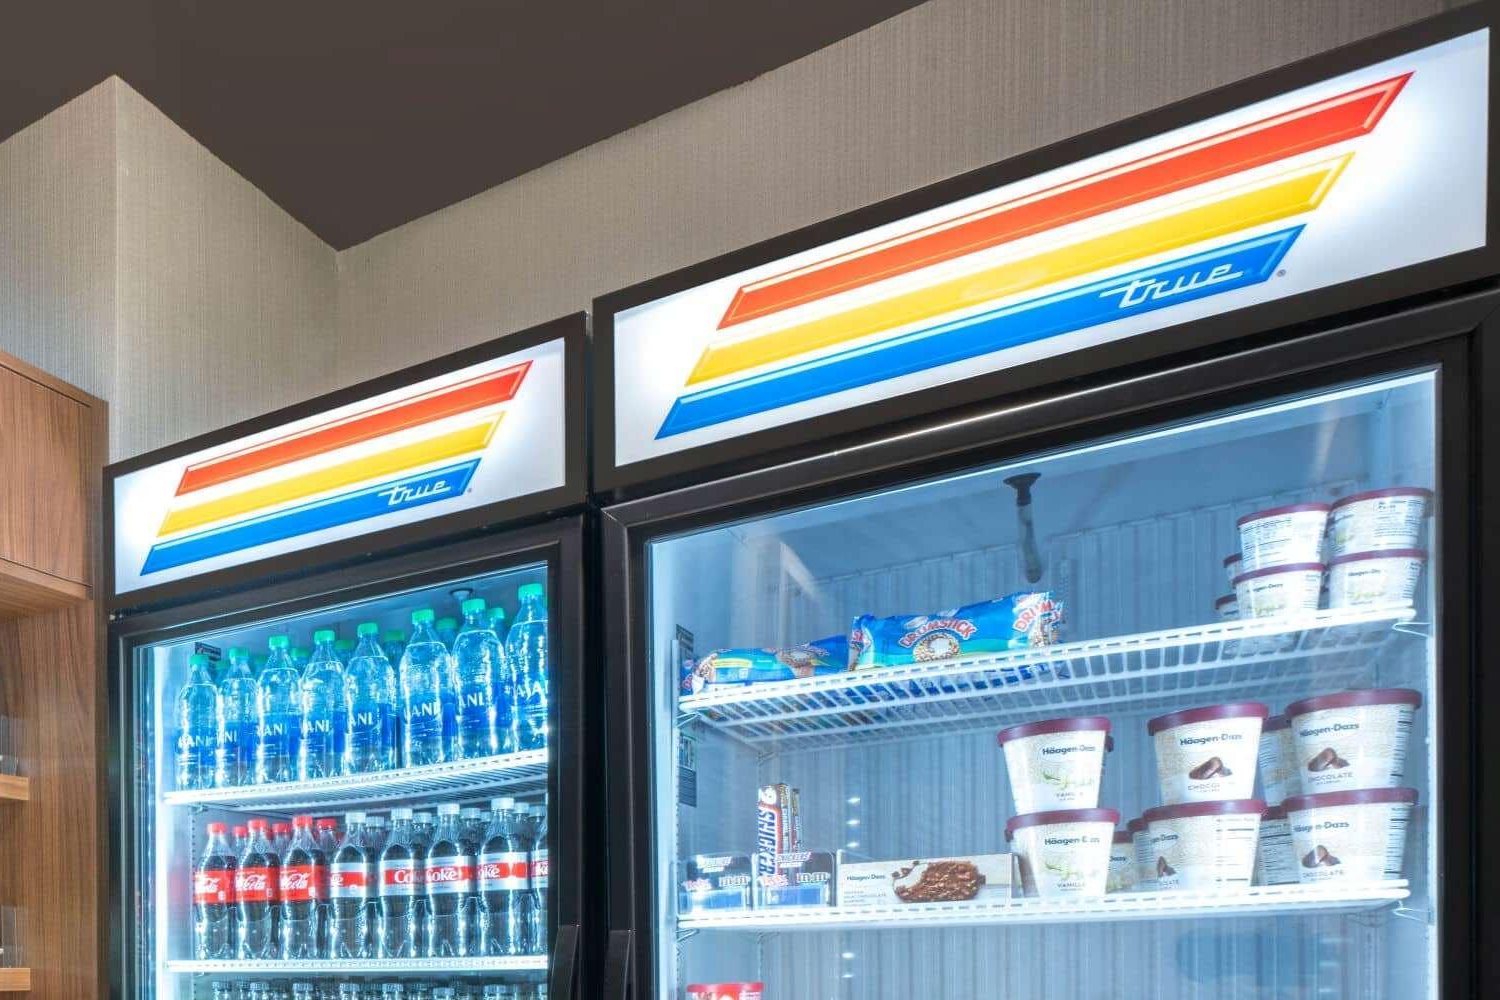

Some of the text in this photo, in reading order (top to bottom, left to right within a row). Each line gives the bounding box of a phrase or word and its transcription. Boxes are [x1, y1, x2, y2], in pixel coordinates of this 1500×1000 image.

[1099, 264, 1244, 309] true
[378, 479, 452, 506] true
[900, 618, 978, 648] DRUMSTICK
